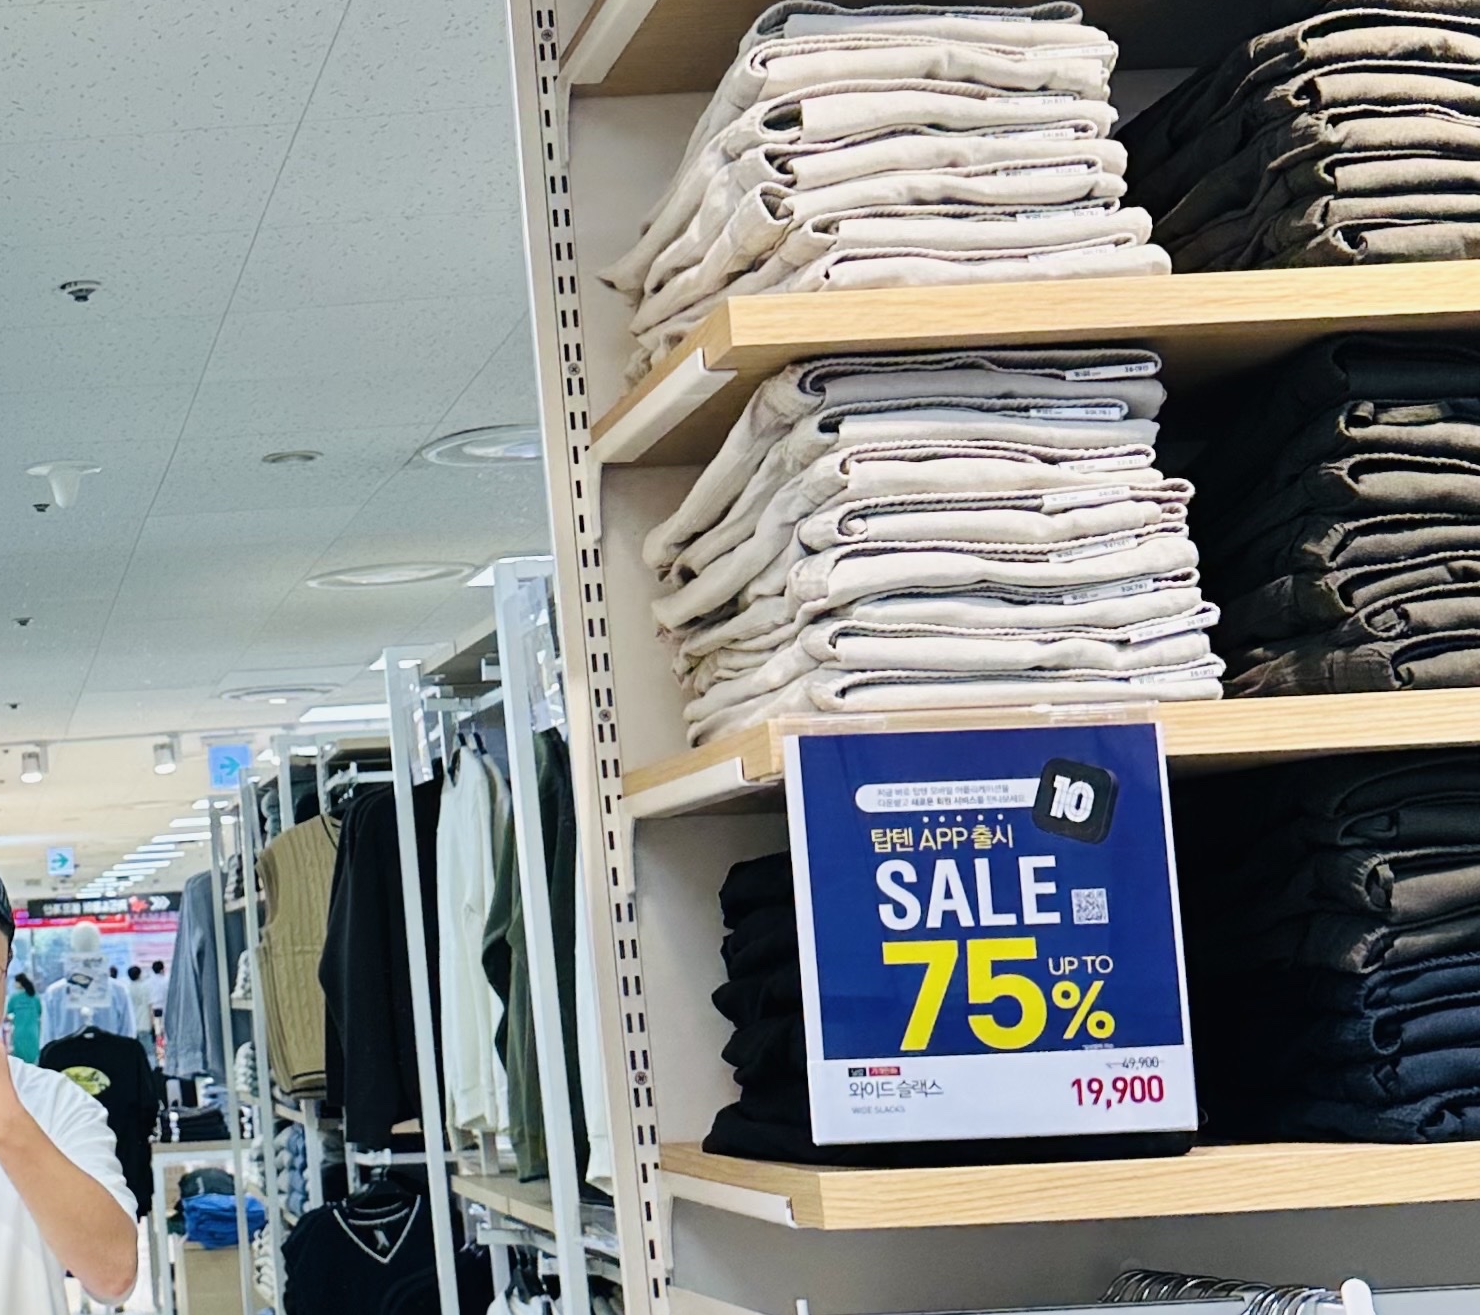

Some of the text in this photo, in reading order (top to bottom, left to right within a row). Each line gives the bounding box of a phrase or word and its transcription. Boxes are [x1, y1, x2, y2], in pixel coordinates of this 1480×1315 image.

[1050, 775, 1095, 823] 10
[871, 823, 1014, 853] 탑텐 APP 출시
[875, 854, 1062, 931] SALE
[1048, 955, 1115, 976] UP TO
[1122, 1055, 1160, 1071] 49,900
[849, 1078, 944, 1099] 와이드 슬랙스
[1071, 1074, 1165, 1111] 19,900
